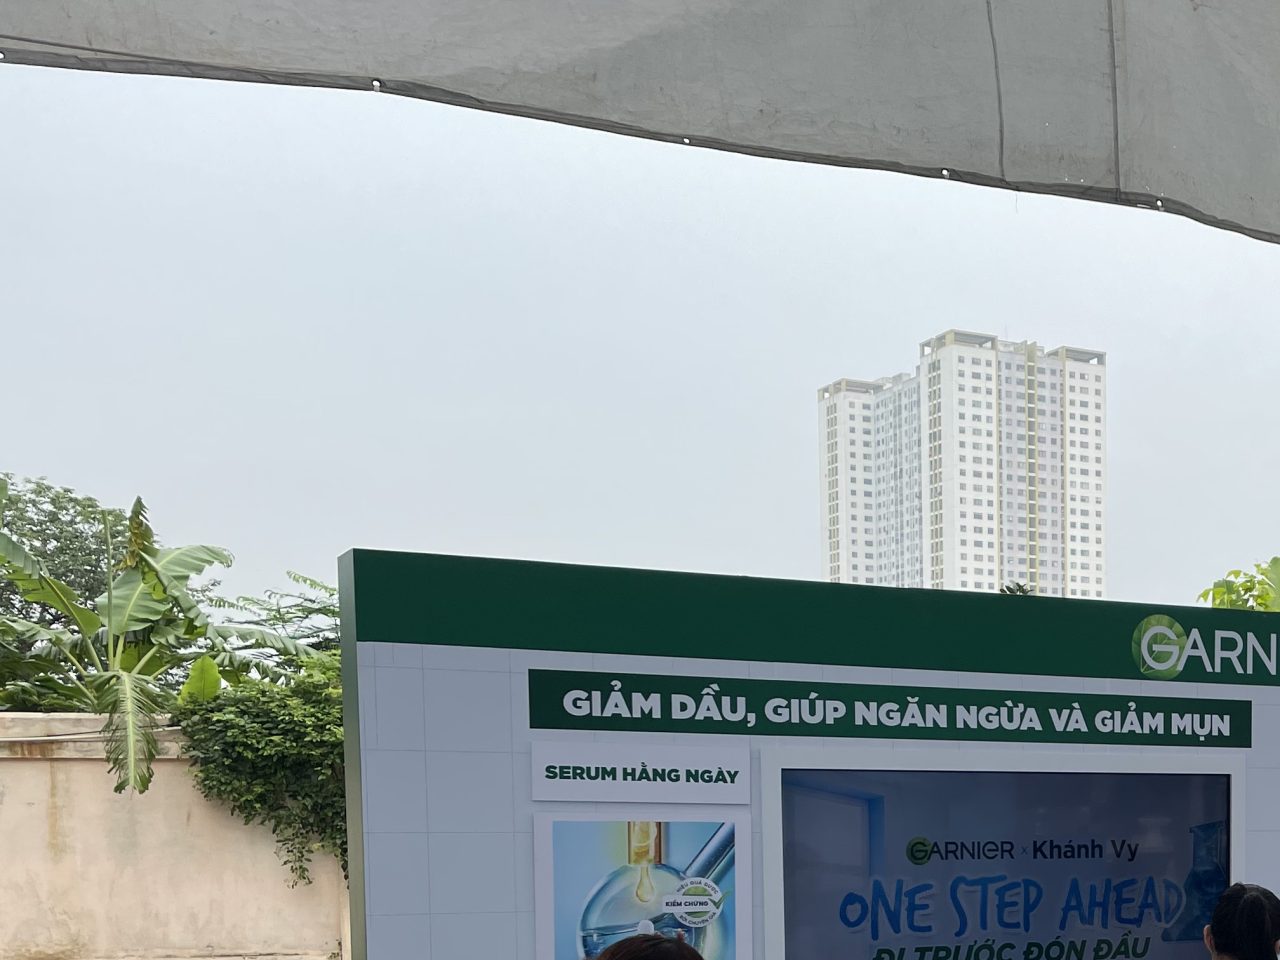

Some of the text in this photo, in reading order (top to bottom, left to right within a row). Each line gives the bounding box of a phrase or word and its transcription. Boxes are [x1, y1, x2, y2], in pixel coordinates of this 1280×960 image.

[562, 680, 1231, 741] GIẢM DẦU, GIÚP NGĂN NGỪA VÀ GIẢM MỤN
[544, 761, 740, 784] SERUM HẰNG NGÀY
[1031, 839, 1104, 860] Khánh
[1111, 840, 1140, 862] Vy
[838, 875, 1185, 941] ONE STEP AHEAD
[1092, 929, 1151, 960] ĐẦU
